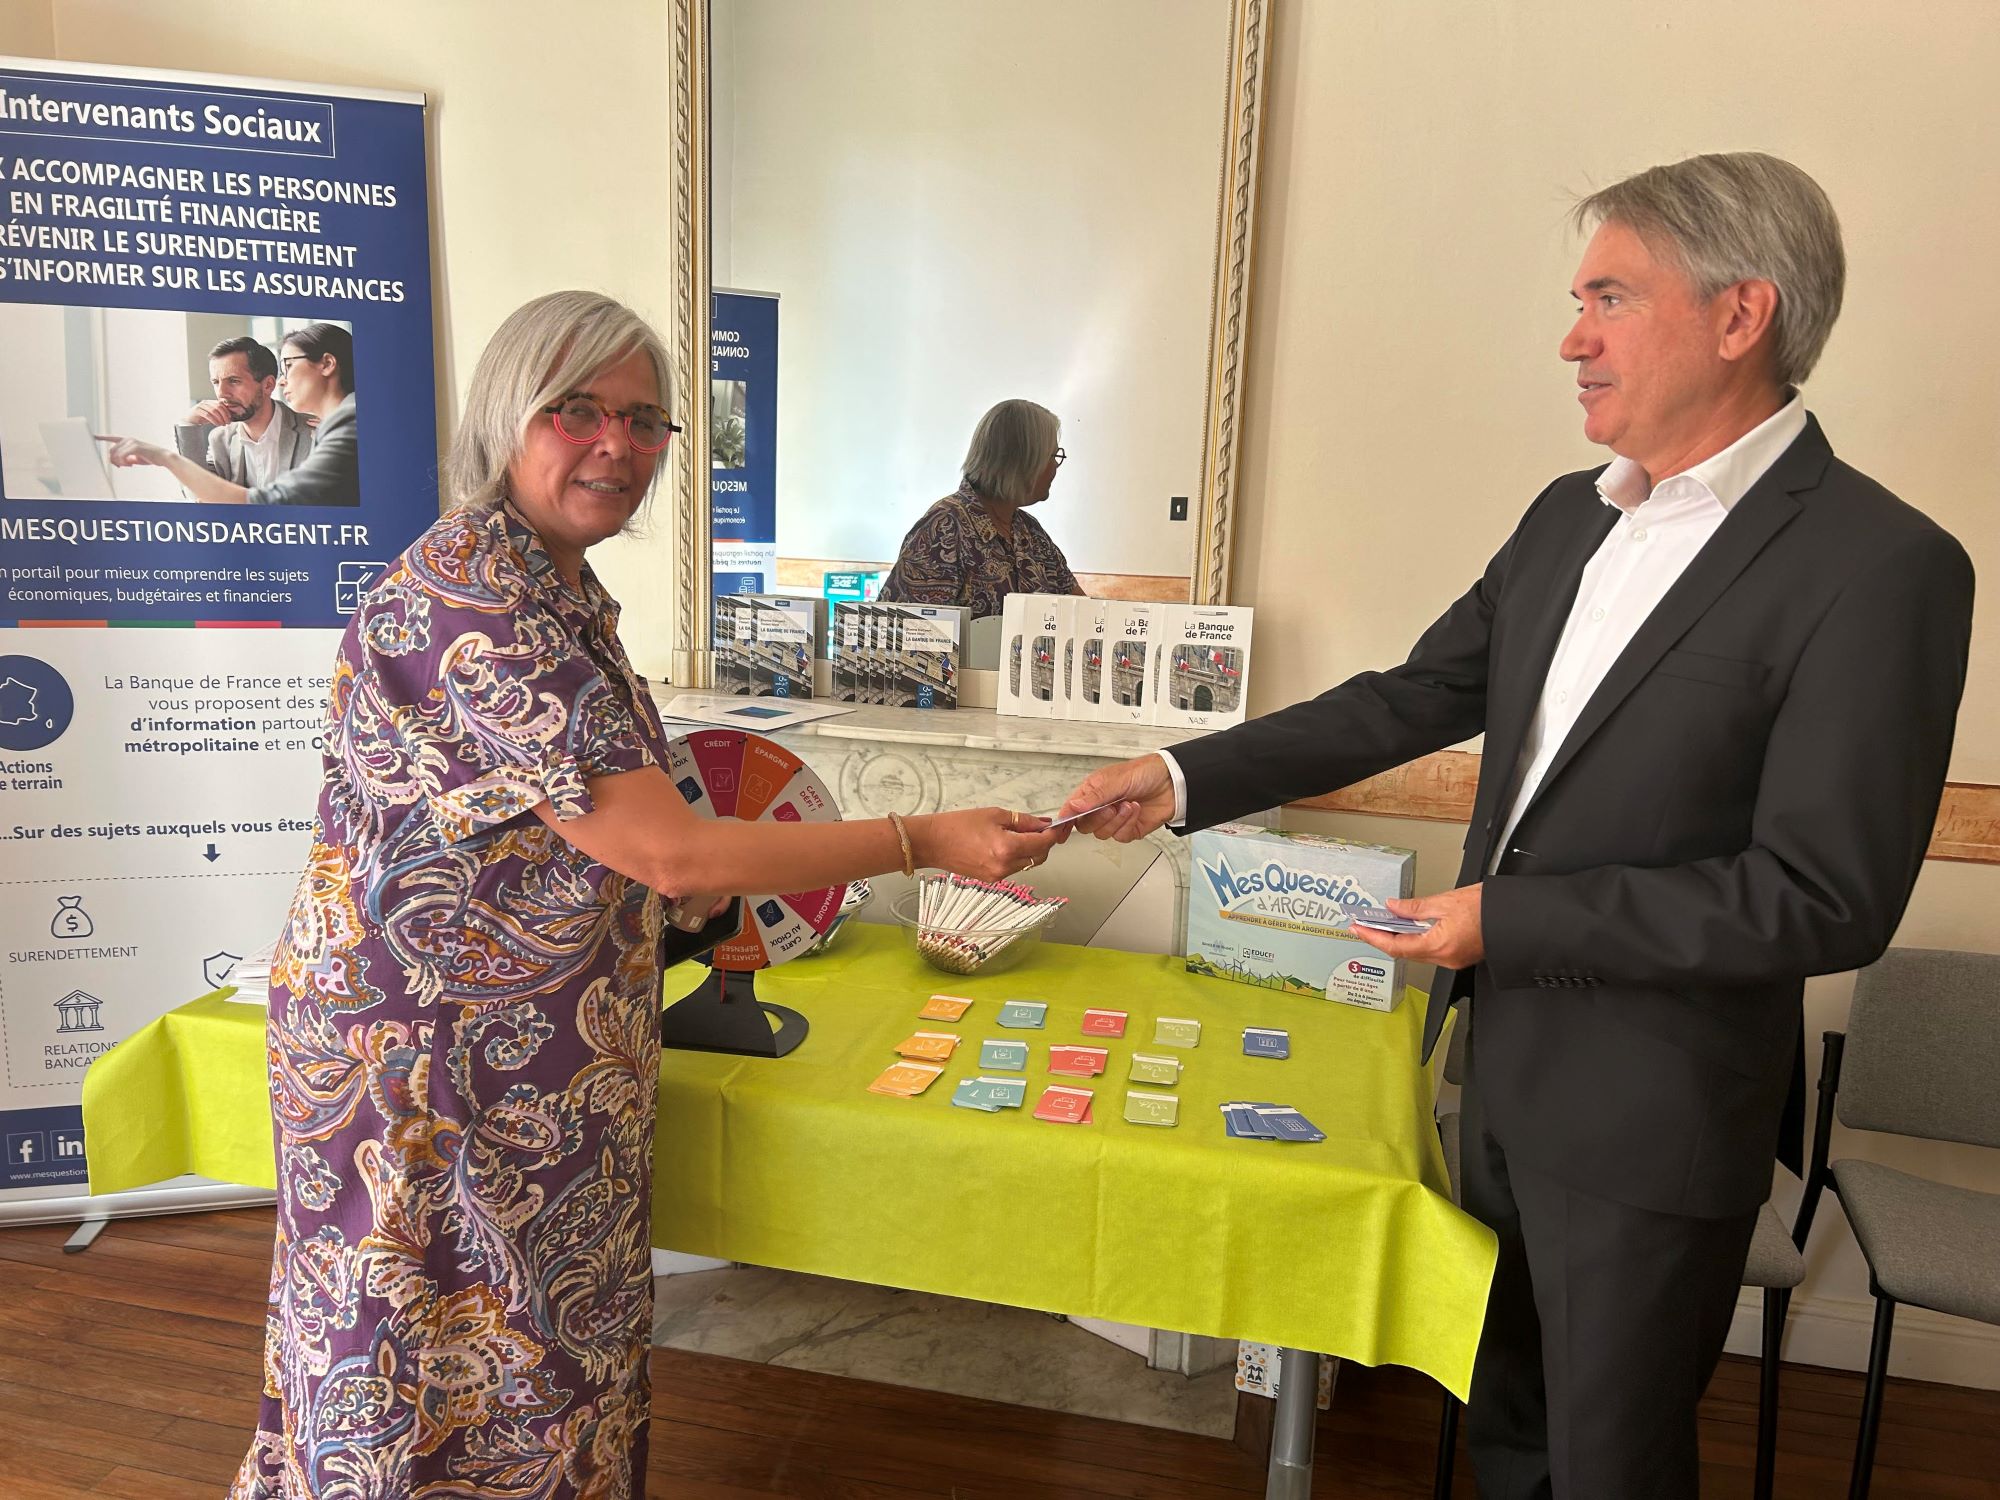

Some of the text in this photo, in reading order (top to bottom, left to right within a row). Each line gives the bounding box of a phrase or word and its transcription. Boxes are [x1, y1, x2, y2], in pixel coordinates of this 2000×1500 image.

[0, 89, 322, 143] Intervenants Sociaux
[12, 158, 206, 193] ACCOMPAGNER
[212, 171, 251, 197] LES
[258, 175, 397, 207] PERSONNES
[11, 191, 321, 234] EN FRAGILITÉ FINANCIÈRE
[103, 230, 130, 253] LE
[136, 232, 357, 268] SURENDETTEMENT
[152, 264, 201, 290] SUR
[207, 269, 246, 294] LES
[252, 272, 405, 303] ASSURANCES
[1, 518, 370, 546] MESQUESTIONSDARGENT.FR
[12, 565, 60, 582] portail
[65, 568, 100, 583] pour
[105, 567, 149, 580] mieux
[153, 568, 242, 584] comprendre
[246, 568, 265, 581] les
[269, 569, 309, 585] sujets
[8, 587, 292, 605] économiques, budgétaires et financiers
[1045, 622, 1057, 630] de
[1125, 618, 1135, 626] La
[1126, 627, 1138, 635] de
[1185, 621, 1234, 633] La Banque
[1185, 630, 1232, 640] de France
[105, 675, 332, 696] La Banque de France et ses
[149, 698, 189, 711] vous
[195, 697, 281, 715] proposent
[287, 695, 315, 709] des
[130, 717, 323, 734] d'information partout
[125, 738, 259, 755] métropolitaine
[265, 740, 281, 751] et
[287, 740, 305, 750] en
[704, 740, 731, 748] CRÉDIT
[754, 746, 790, 770] ÉPARGNE
[11, 775, 63, 790] terrain
[806, 785, 824, 808] CARTE
[51, 824, 82, 838] des
[87, 823, 141, 840] sujets
[146, 820, 226, 838] auxquels
[231, 821, 272, 834] vous
[278, 818, 313, 832] êtes
[1228, 914, 1261, 924] APPRENDRE
[1301, 925, 1325, 935] ARGENT
[770, 924, 801, 947] AU CHOIX
[780, 936, 802, 952] CARTE
[9, 947, 138, 963] SURENDETTEMENT
[1351, 963, 1358, 971] 3
[45, 1057, 100, 1070] BANCA
[57, 1136, 83, 1156] in
